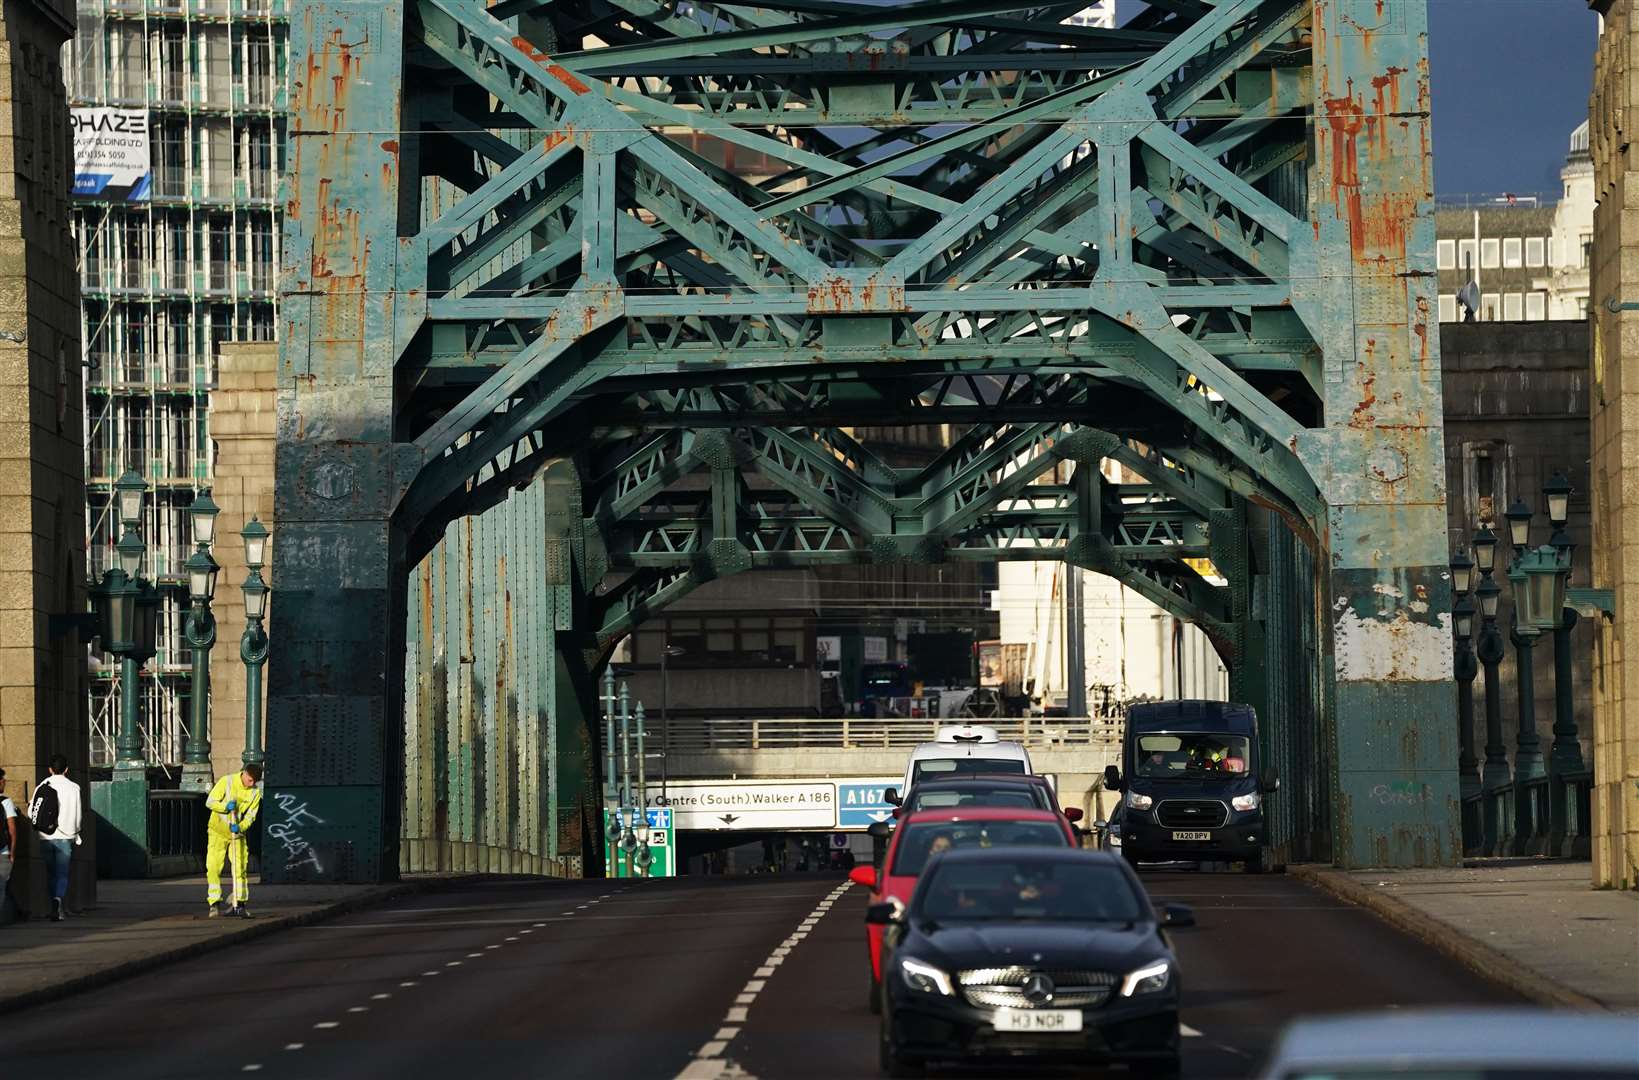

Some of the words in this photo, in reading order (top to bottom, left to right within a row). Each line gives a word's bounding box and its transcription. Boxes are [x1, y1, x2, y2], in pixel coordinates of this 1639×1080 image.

[108, 151, 126, 159] 5050
[655, 795, 697, 807] Centre
[752, 792, 794, 804] Walker
[1175, 832, 1194, 840] YA20
[1195, 832, 1208, 840] BPV
[1012, 1014, 1031, 1028] H3
[1037, 1014, 1064, 1029] NOR
